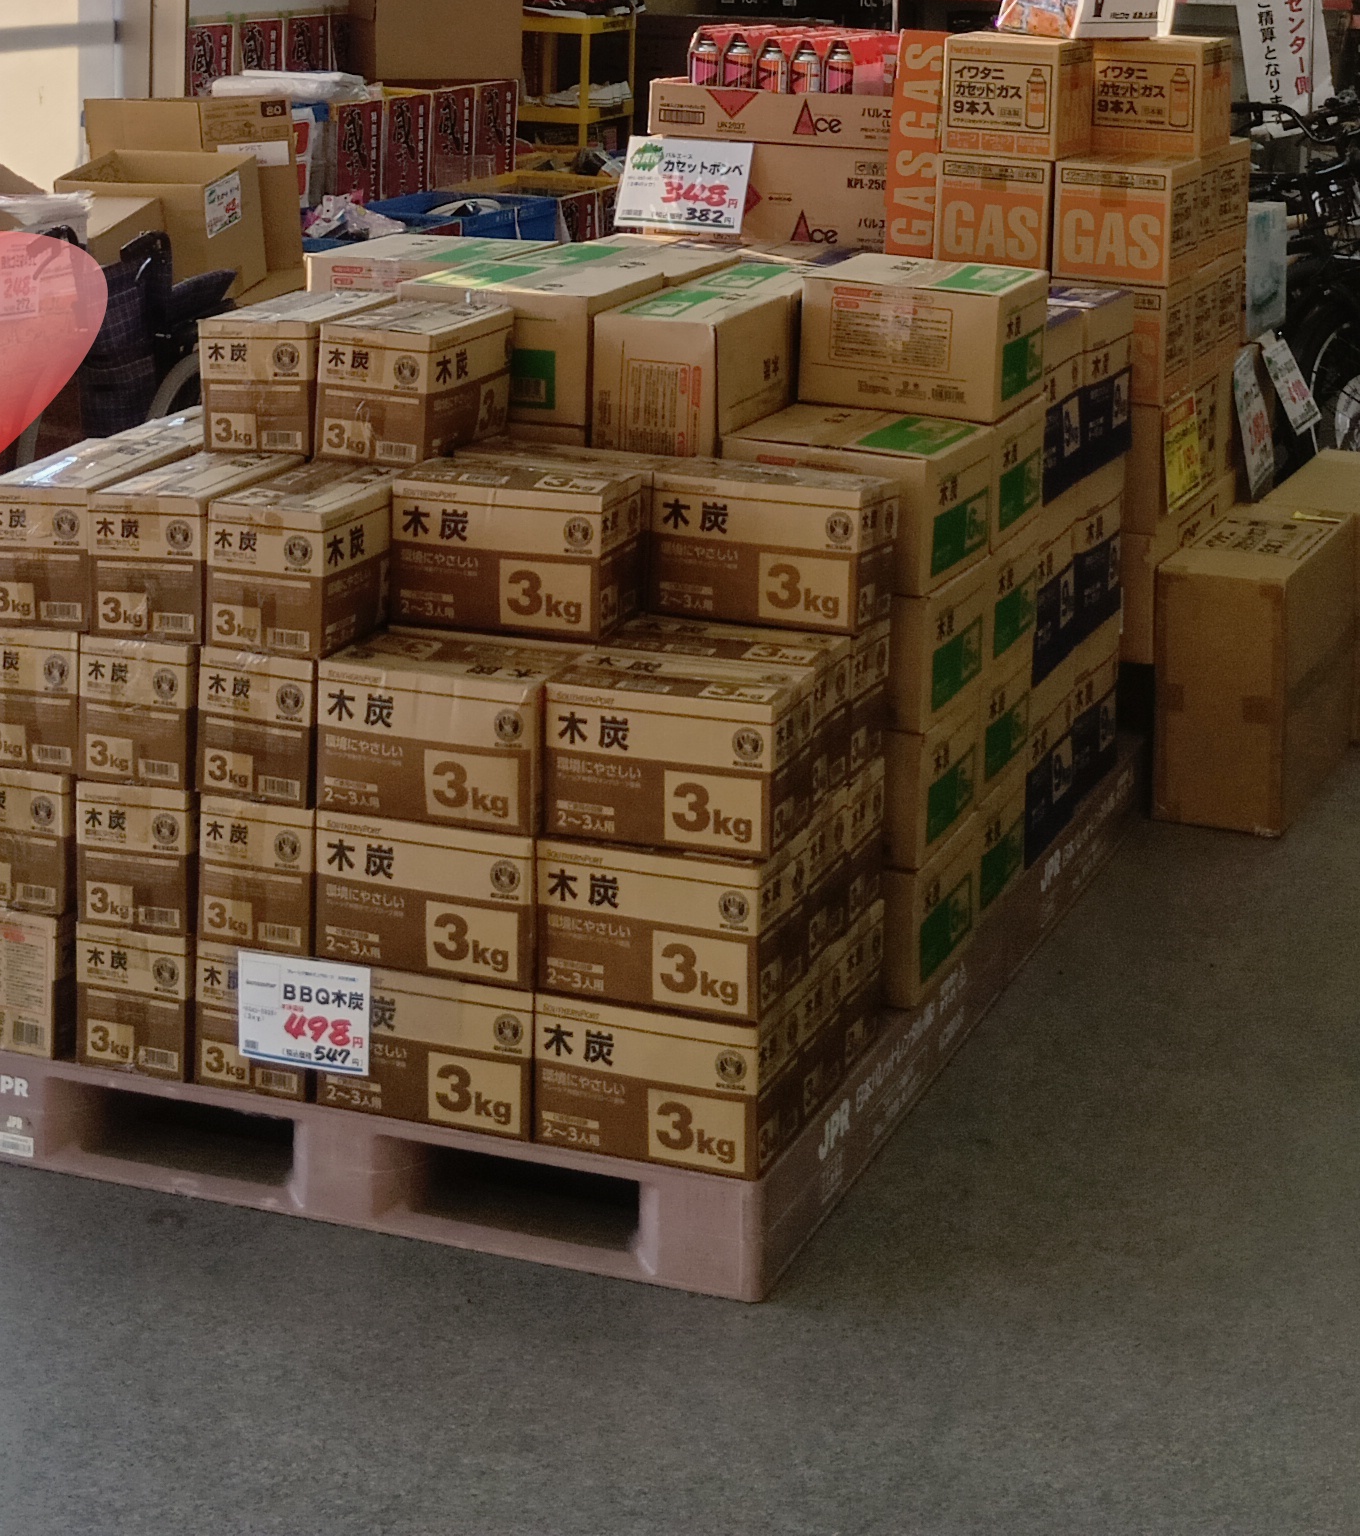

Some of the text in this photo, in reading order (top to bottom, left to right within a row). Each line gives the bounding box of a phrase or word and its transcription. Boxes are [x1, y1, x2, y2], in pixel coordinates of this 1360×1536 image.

[955, 67, 1004, 80] イワタニ
[1099, 66, 1148, 80] イワタニ
[900, 43, 943, 139] GAS
[953, 101, 994, 115] 9本入
[1097, 100, 1138, 114] 9本入
[793, 98, 842, 135] Ace
[862, 108, 891, 117] バルエ
[664, 160, 744, 176] カセットボンベ
[891, 150, 937, 246] GAS
[790, 210, 838, 244] Ace
[943, 200, 1038, 260] GAS
[1063, 209, 1160, 269] GAS
[208, 343, 248, 362] 木炭
[328, 348, 369, 370] 木炭
[436, 349, 468, 385] 木炭
[215, 418, 252, 445] 3kg
[327, 423, 366, 454] 3kg
[96, 518, 139, 538] 木炭
[402, 507, 468, 542] 木炭
[663, 499, 729, 535] 木炭
[215, 529, 257, 550] 木炭
[327, 524, 365, 566] 木炭
[506, 569, 582, 623] 3kg
[766, 564, 840, 619] 3kg
[103, 597, 142, 626] 3kg
[216, 609, 257, 639] 3kg
[88, 660, 128, 684] 木炭
[209, 674, 250, 699] 木炭
[328, 690, 394, 727] 木炭
[558, 712, 629, 751] 木炭
[90, 740, 130, 771] 3kg
[208, 754, 248, 787] 3kg
[433, 761, 509, 818] 3kg
[85, 807, 126, 832] 木炭
[672, 782, 752, 843] 3kg
[206, 820, 248, 844] 木炭
[327, 839, 394, 880] 木炭
[90, 887, 130, 919] 3kg
[547, 868, 619, 909] 木炭
[208, 901, 248, 936] 3kg
[87, 948, 127, 971] 木炭
[433, 914, 510, 972] 3kg
[660, 943, 738, 1006] 3kg
[284, 984, 364, 1010] BBQ木炭
[91, 1026, 130, 1058] 3kg
[205, 1039, 245, 1079] 3kg
[543, 1024, 615, 1067] 木炭
[436, 1065, 512, 1126] 3kg
[656, 1103, 735, 1163] 3kg
